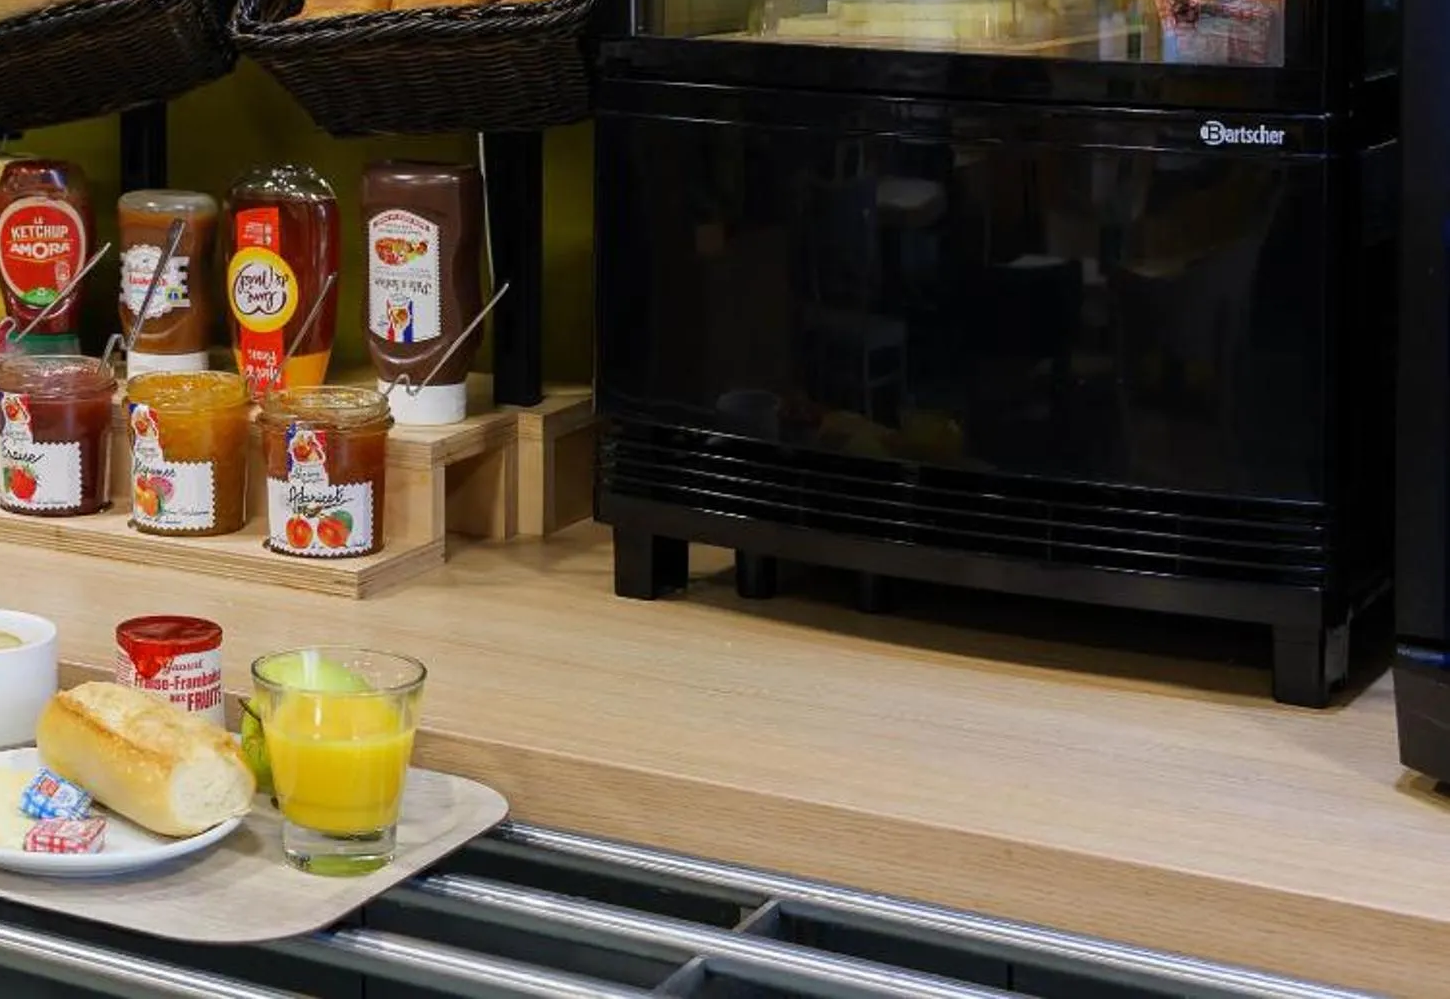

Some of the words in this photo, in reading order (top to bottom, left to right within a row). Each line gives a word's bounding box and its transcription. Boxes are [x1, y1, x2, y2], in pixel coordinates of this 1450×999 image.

[1200, 120, 1286, 146] Bartscher
[33, 215, 44, 225] LE
[11, 224, 69, 242] KETCHUP
[10, 242, 70, 259] AMORA
